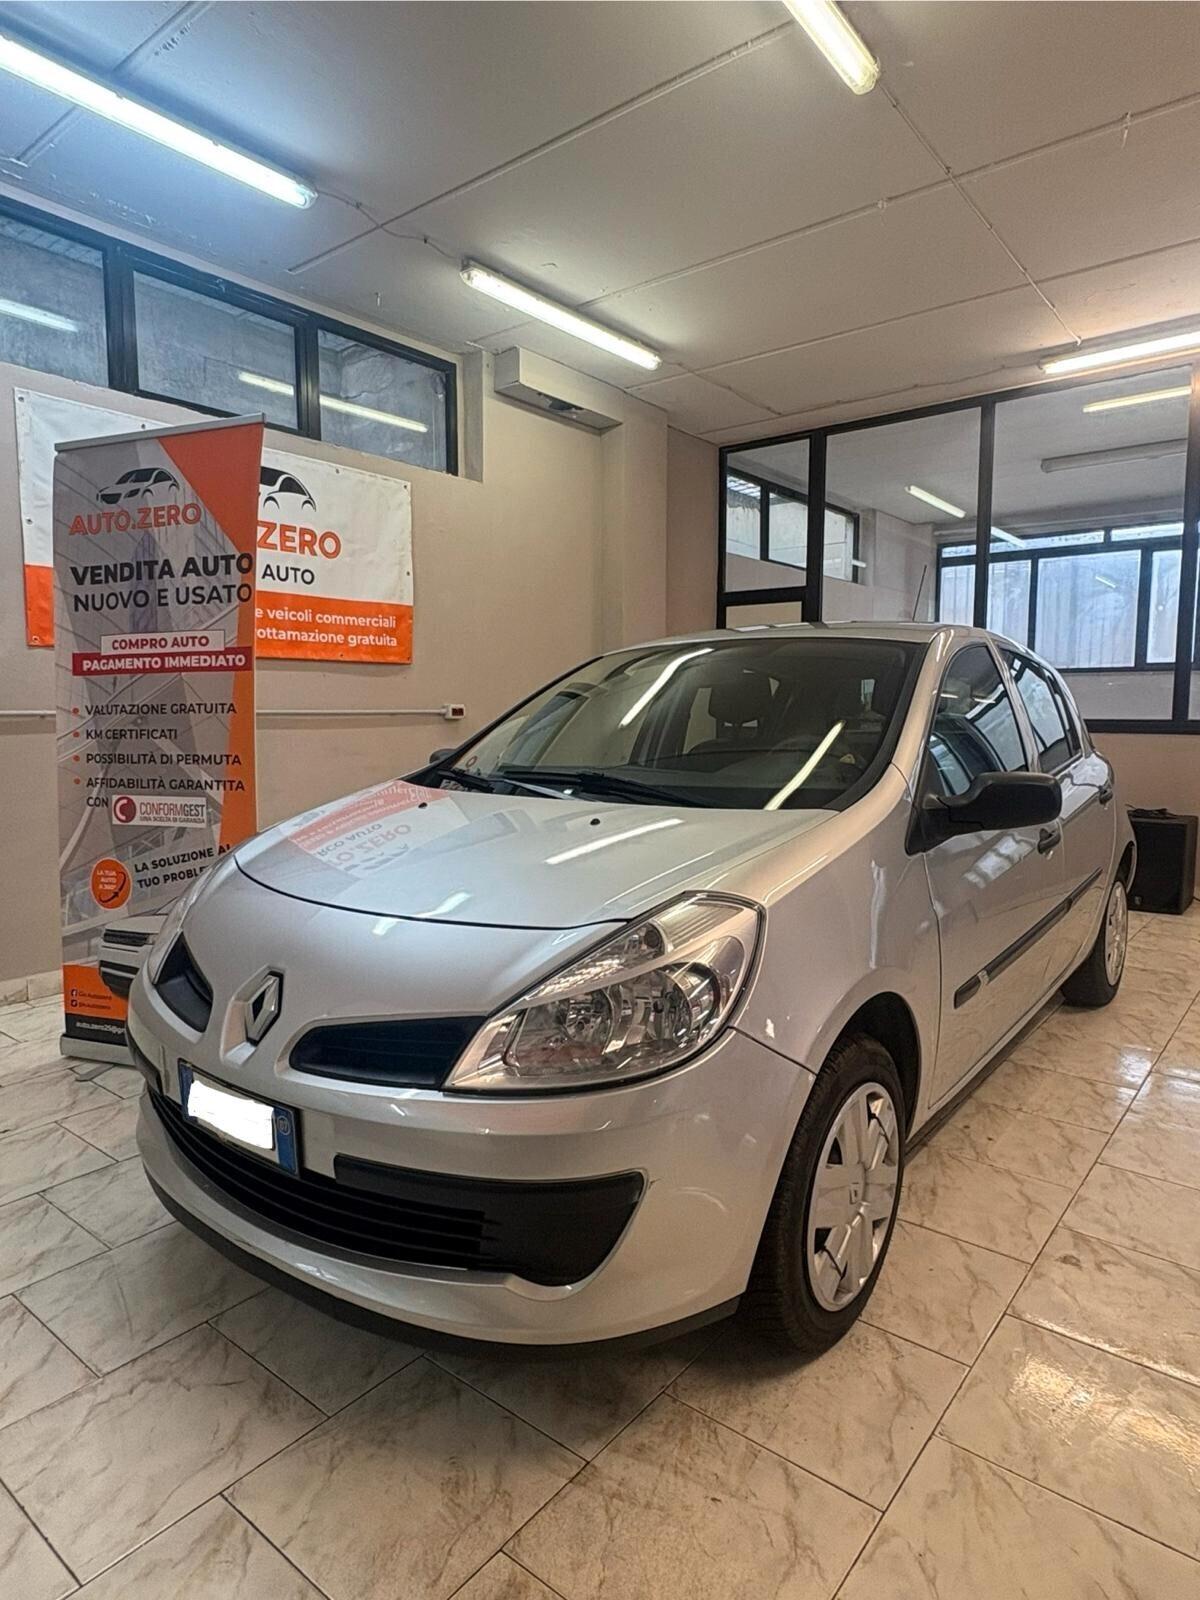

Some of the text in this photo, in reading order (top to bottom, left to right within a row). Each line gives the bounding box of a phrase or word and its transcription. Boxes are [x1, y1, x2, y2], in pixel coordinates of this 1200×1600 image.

[68, 502, 201, 536] AUTO.ZERO
[69, 552, 253, 587] VENDITA AUTO
[261, 563, 315, 585] AUTO
[74, 584, 253, 612] NUOVO E USATO
[267, 606, 313, 623] veicoli
[315, 611, 397, 628] commerciali
[112, 634, 210, 650] COMPRO AUTO
[256, 627, 398, 647] ottamazione gratuita
[82, 653, 246, 672] PAGAMENTO IMMEDIATO
[85, 702, 237, 716] VALUTAZIONE GRATUITA
[85, 728, 178, 741] KM CERTIFICATI
[86, 751, 242, 766] POSSIBILITÀ DI PERMUTA
[86, 774, 245, 792] AFFIDABILITÀ GARANTITA
[86, 796, 109, 809] CON
[139, 802, 206, 818] CONFORMGEST
[134, 862, 150, 873] LA
[151, 847, 214, 870] SOLUZIONE
[137, 876, 161, 889] TUO
